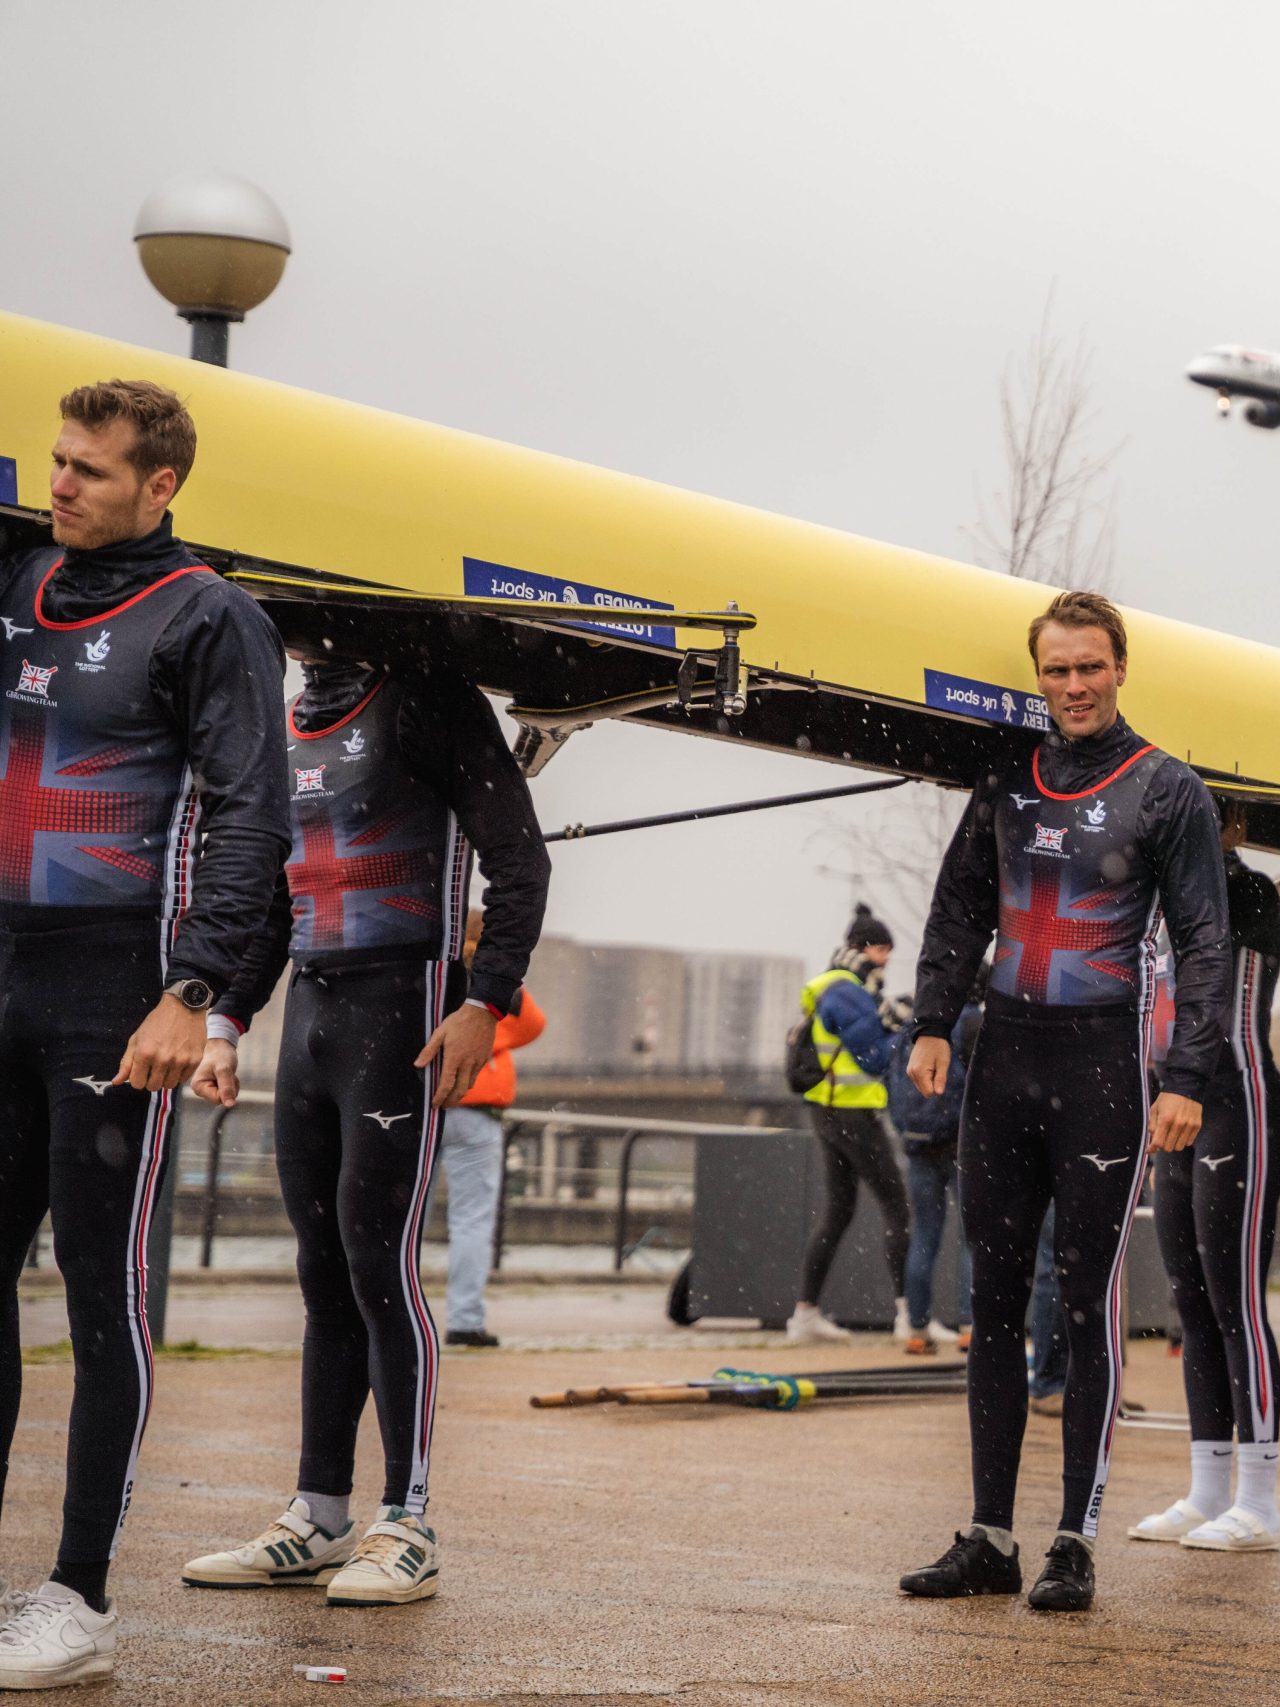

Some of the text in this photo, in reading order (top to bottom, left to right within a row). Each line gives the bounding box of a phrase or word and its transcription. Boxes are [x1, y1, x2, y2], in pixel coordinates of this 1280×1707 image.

[491, 579, 557, 602] uk sport
[946, 687, 997, 711] uk sport
[1025, 697, 1049, 715] DED
[1022, 712, 1051, 731] TERY
[1089, 1484, 1105, 1518] GBR
